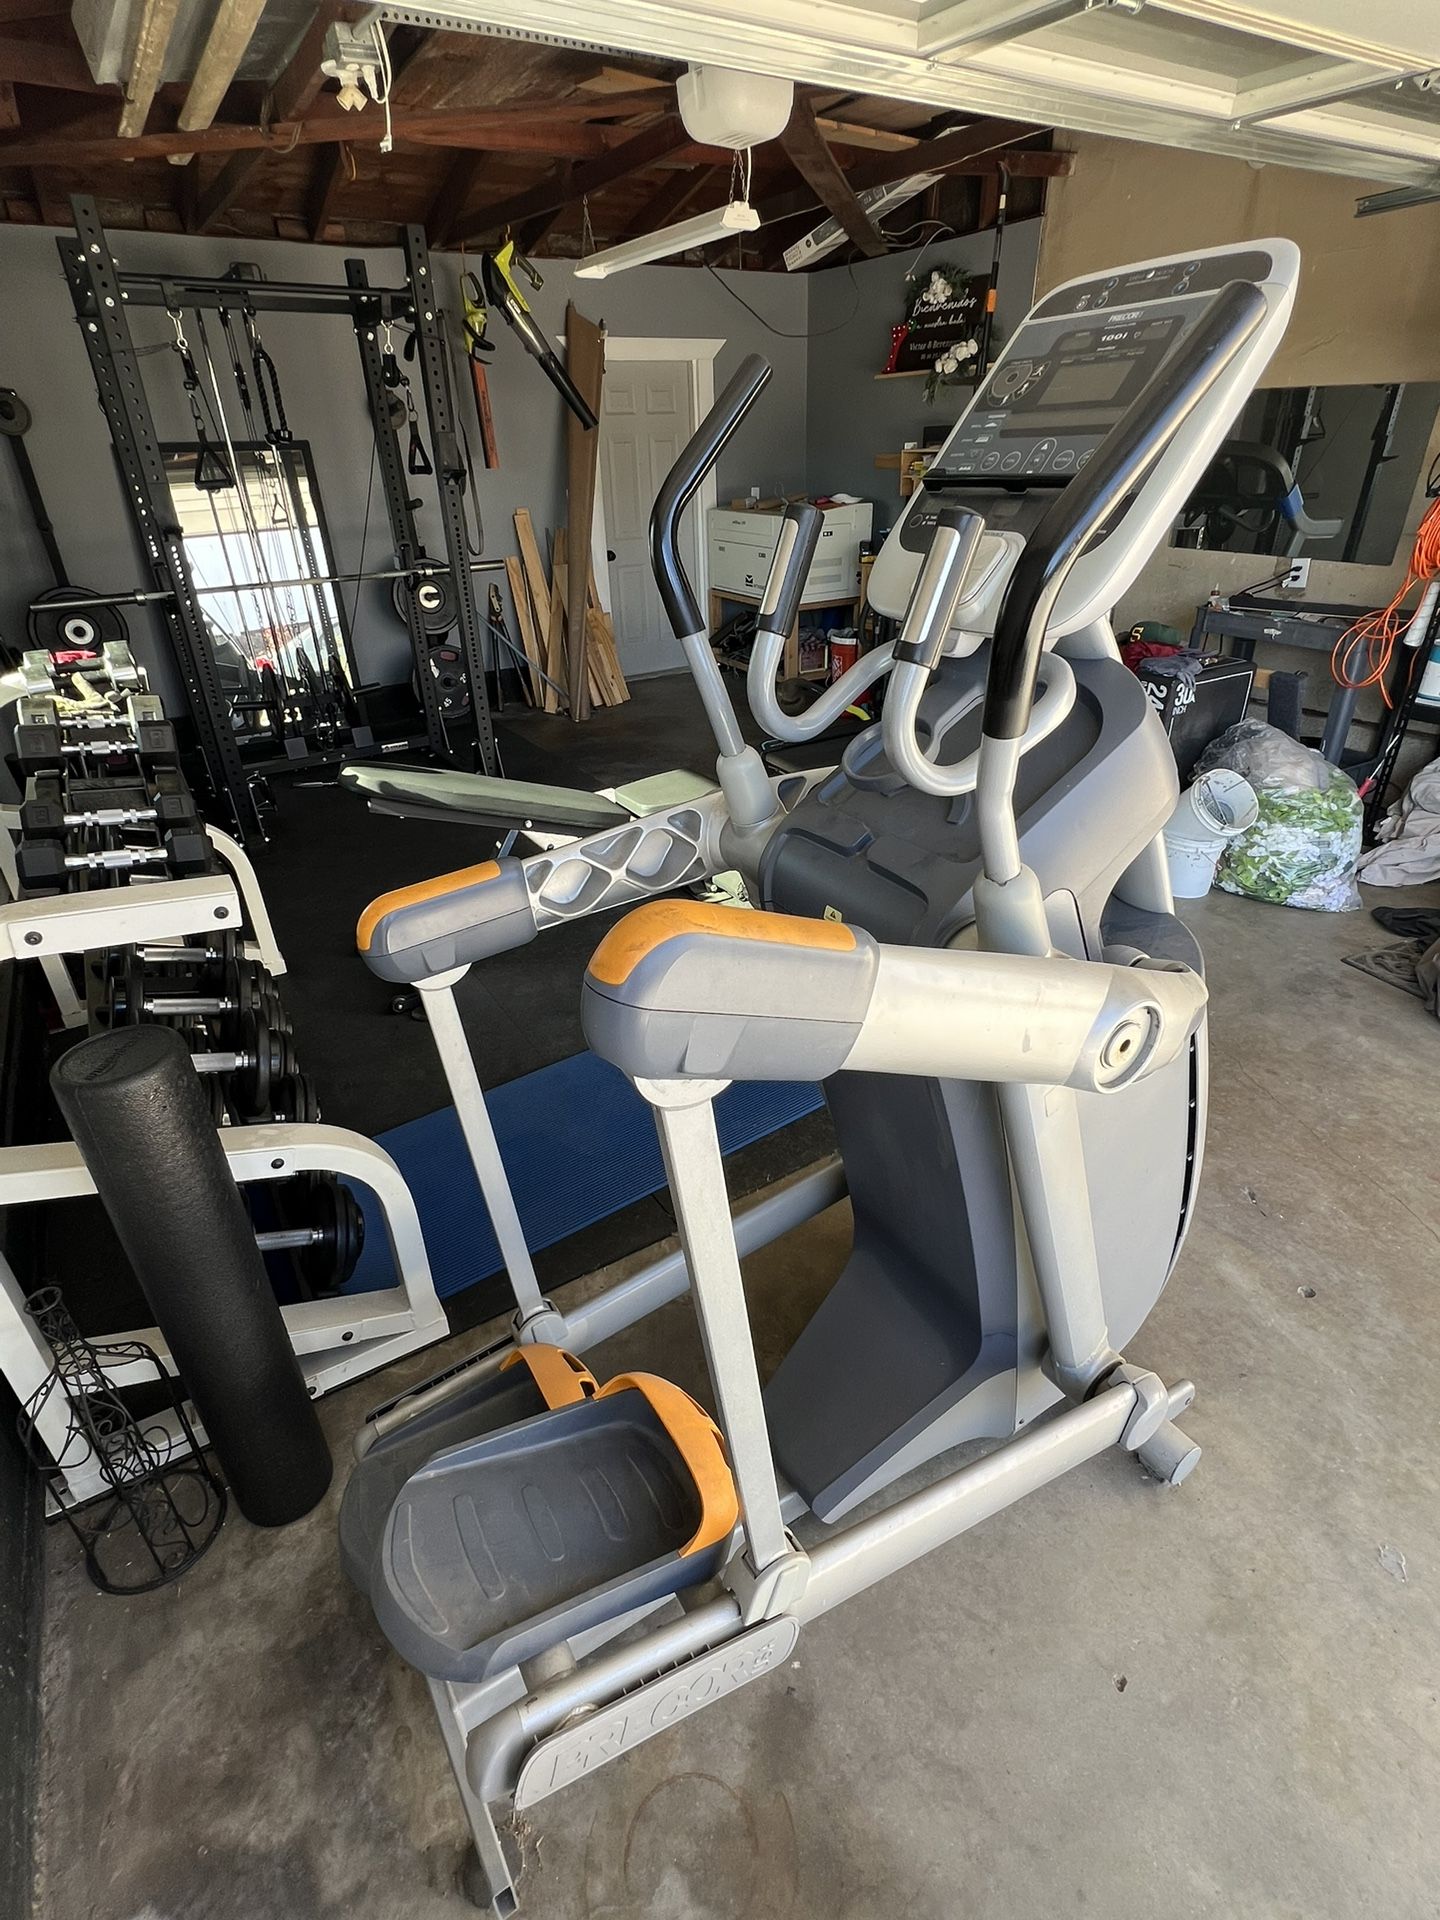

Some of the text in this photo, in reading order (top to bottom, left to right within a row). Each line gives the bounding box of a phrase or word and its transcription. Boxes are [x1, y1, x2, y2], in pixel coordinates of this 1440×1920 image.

[1107, 311, 1140, 323] PRECOR
[910, 342, 926, 350] Victor
[1130, 627, 1145, 642] S
[443, 697, 452, 707] 45
